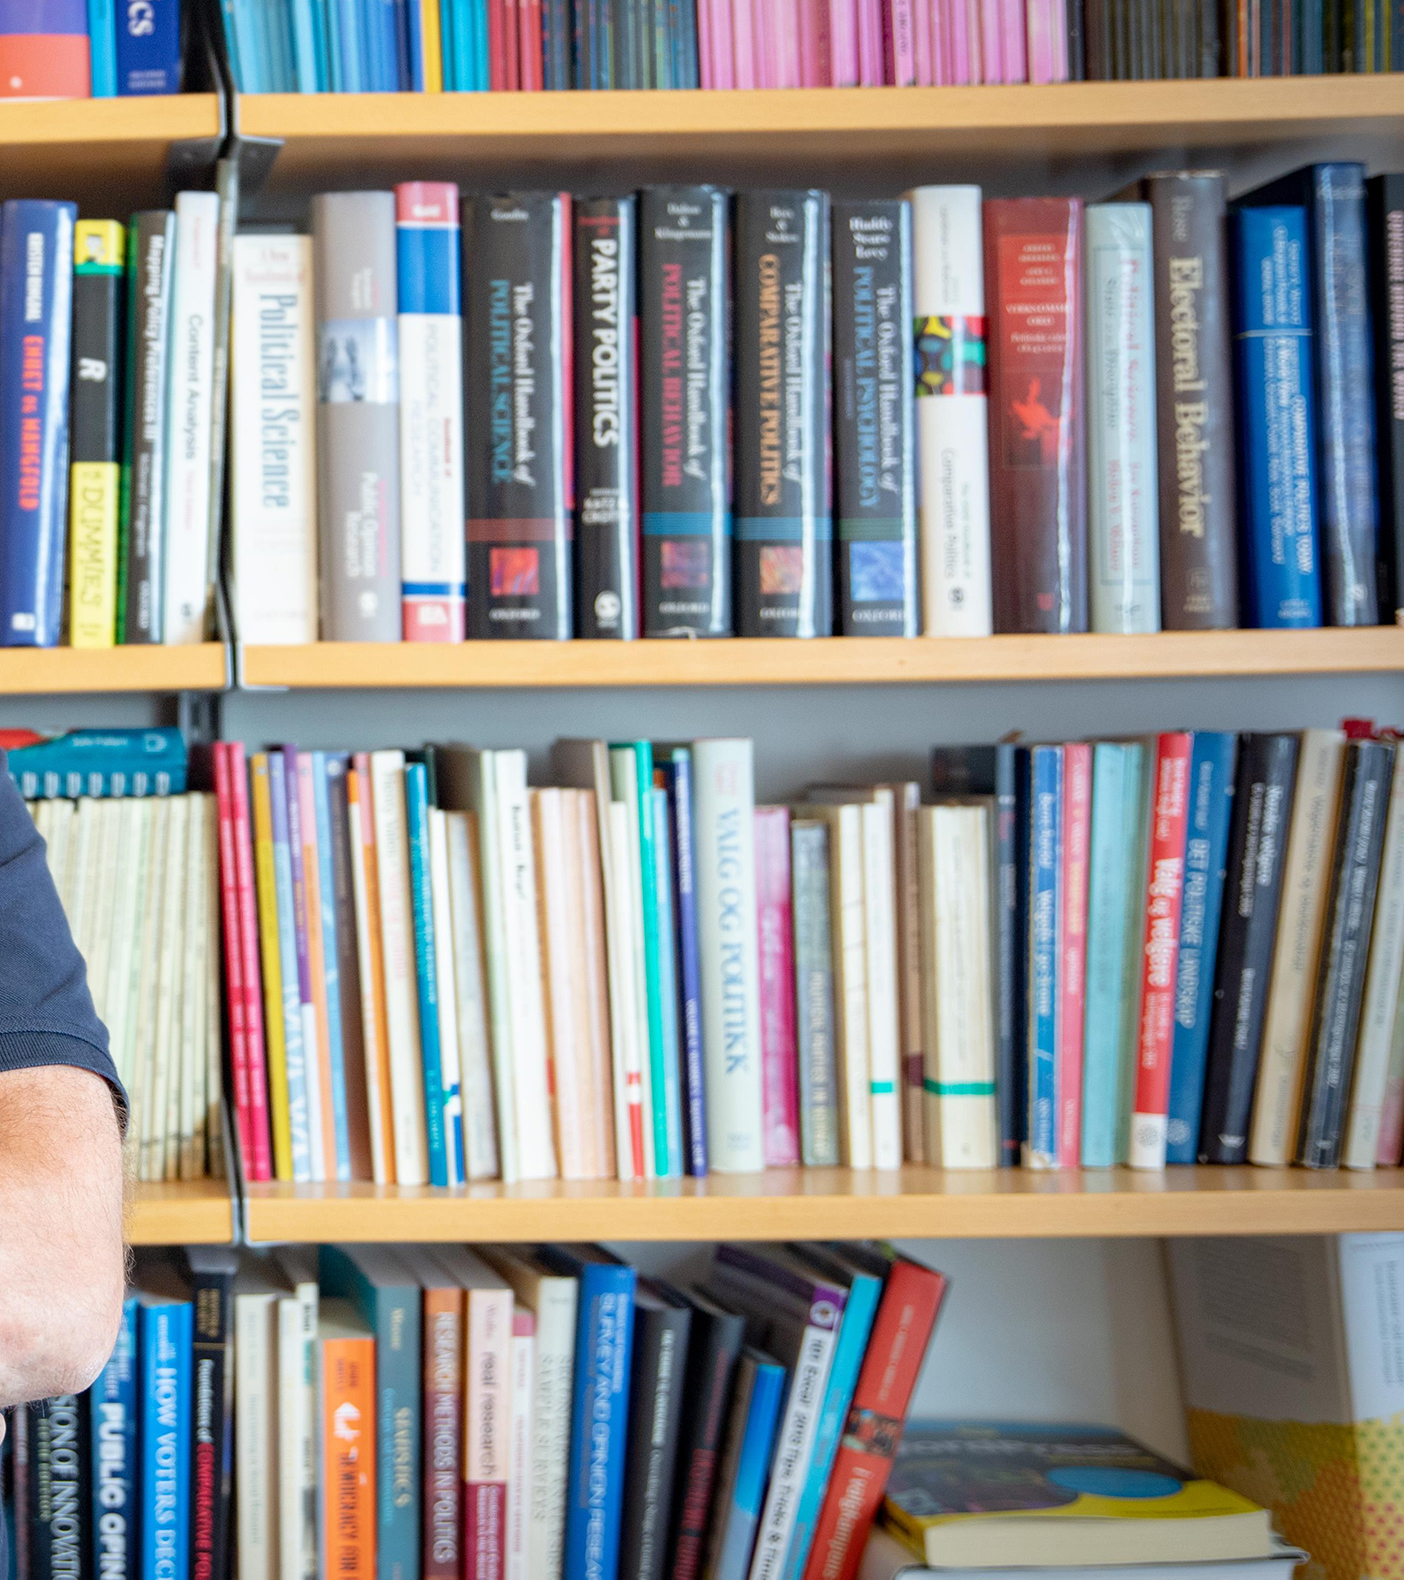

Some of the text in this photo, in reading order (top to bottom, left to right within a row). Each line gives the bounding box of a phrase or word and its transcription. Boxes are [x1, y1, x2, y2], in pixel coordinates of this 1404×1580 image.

[146, 234, 164, 295] Mapping
[22, 334, 44, 391] ENHET
[144, 298, 162, 339] Policy
[591, 238, 619, 448] PARTY POLITICS
[78, 357, 108, 382] R
[143, 341, 162, 423] Preferences
[184, 314, 203, 461] Content Analysis
[259, 293, 300, 508] Political Science
[489, 278, 512, 485] POLITICAL SCIENCE
[513, 283, 535, 487] The Oxford Handbook of
[661, 262, 682, 487] POLITICAL BEHAVIOR
[684, 276, 708, 480] The Oxford Handbook of
[758, 254, 781, 505] COMPARATIVE POLITICS
[782, 282, 804, 483] The Oxford Handbook of
[852, 265, 880, 510] POLITICAL PSYCHOLOGY
[876, 286, 899, 494] The Oxford Handbook of
[1168, 256, 1210, 538] Electoral Behavior
[19, 416, 41, 511] MANGFOLD
[81, 486, 107, 606] DUMMIES
[345, 510, 362, 577] Research
[360, 472, 379, 577] Public Opinion
[1150, 857, 1183, 898] Valg
[1187, 838, 1211, 871] DET
[1256, 785, 1284, 886] Norske velgere
[715, 806, 752, 1076] VALG OG POLITIKK
[1145, 917, 1175, 988] velgere
[1148, 899, 1170, 917] og
[1182, 872, 1208, 946] POLITISKE
[597, 1292, 614, 1376] SURVEY
[156, 1367, 177, 1427] HOW
[198, 1359, 214, 1425] Foundations
[198, 1426, 214, 1443] of
[432, 1311, 456, 1564] RESEARCH METHODS IN POLITICS
[479, 1351, 499, 1477] real research
[595, 1376, 612, 1421] AND
[50, 1448, 79, 1477] OF
[98, 1402, 126, 1508] PUBLIC
[154, 1432, 176, 1524] VOTERS
[195, 1442, 214, 1548] COMPARATIVE
[392, 1406, 411, 1507] STATISTICS
[590, 1422, 611, 1503] OPINION
[339, 1453, 360, 1571] DEMOCRACY FOR
